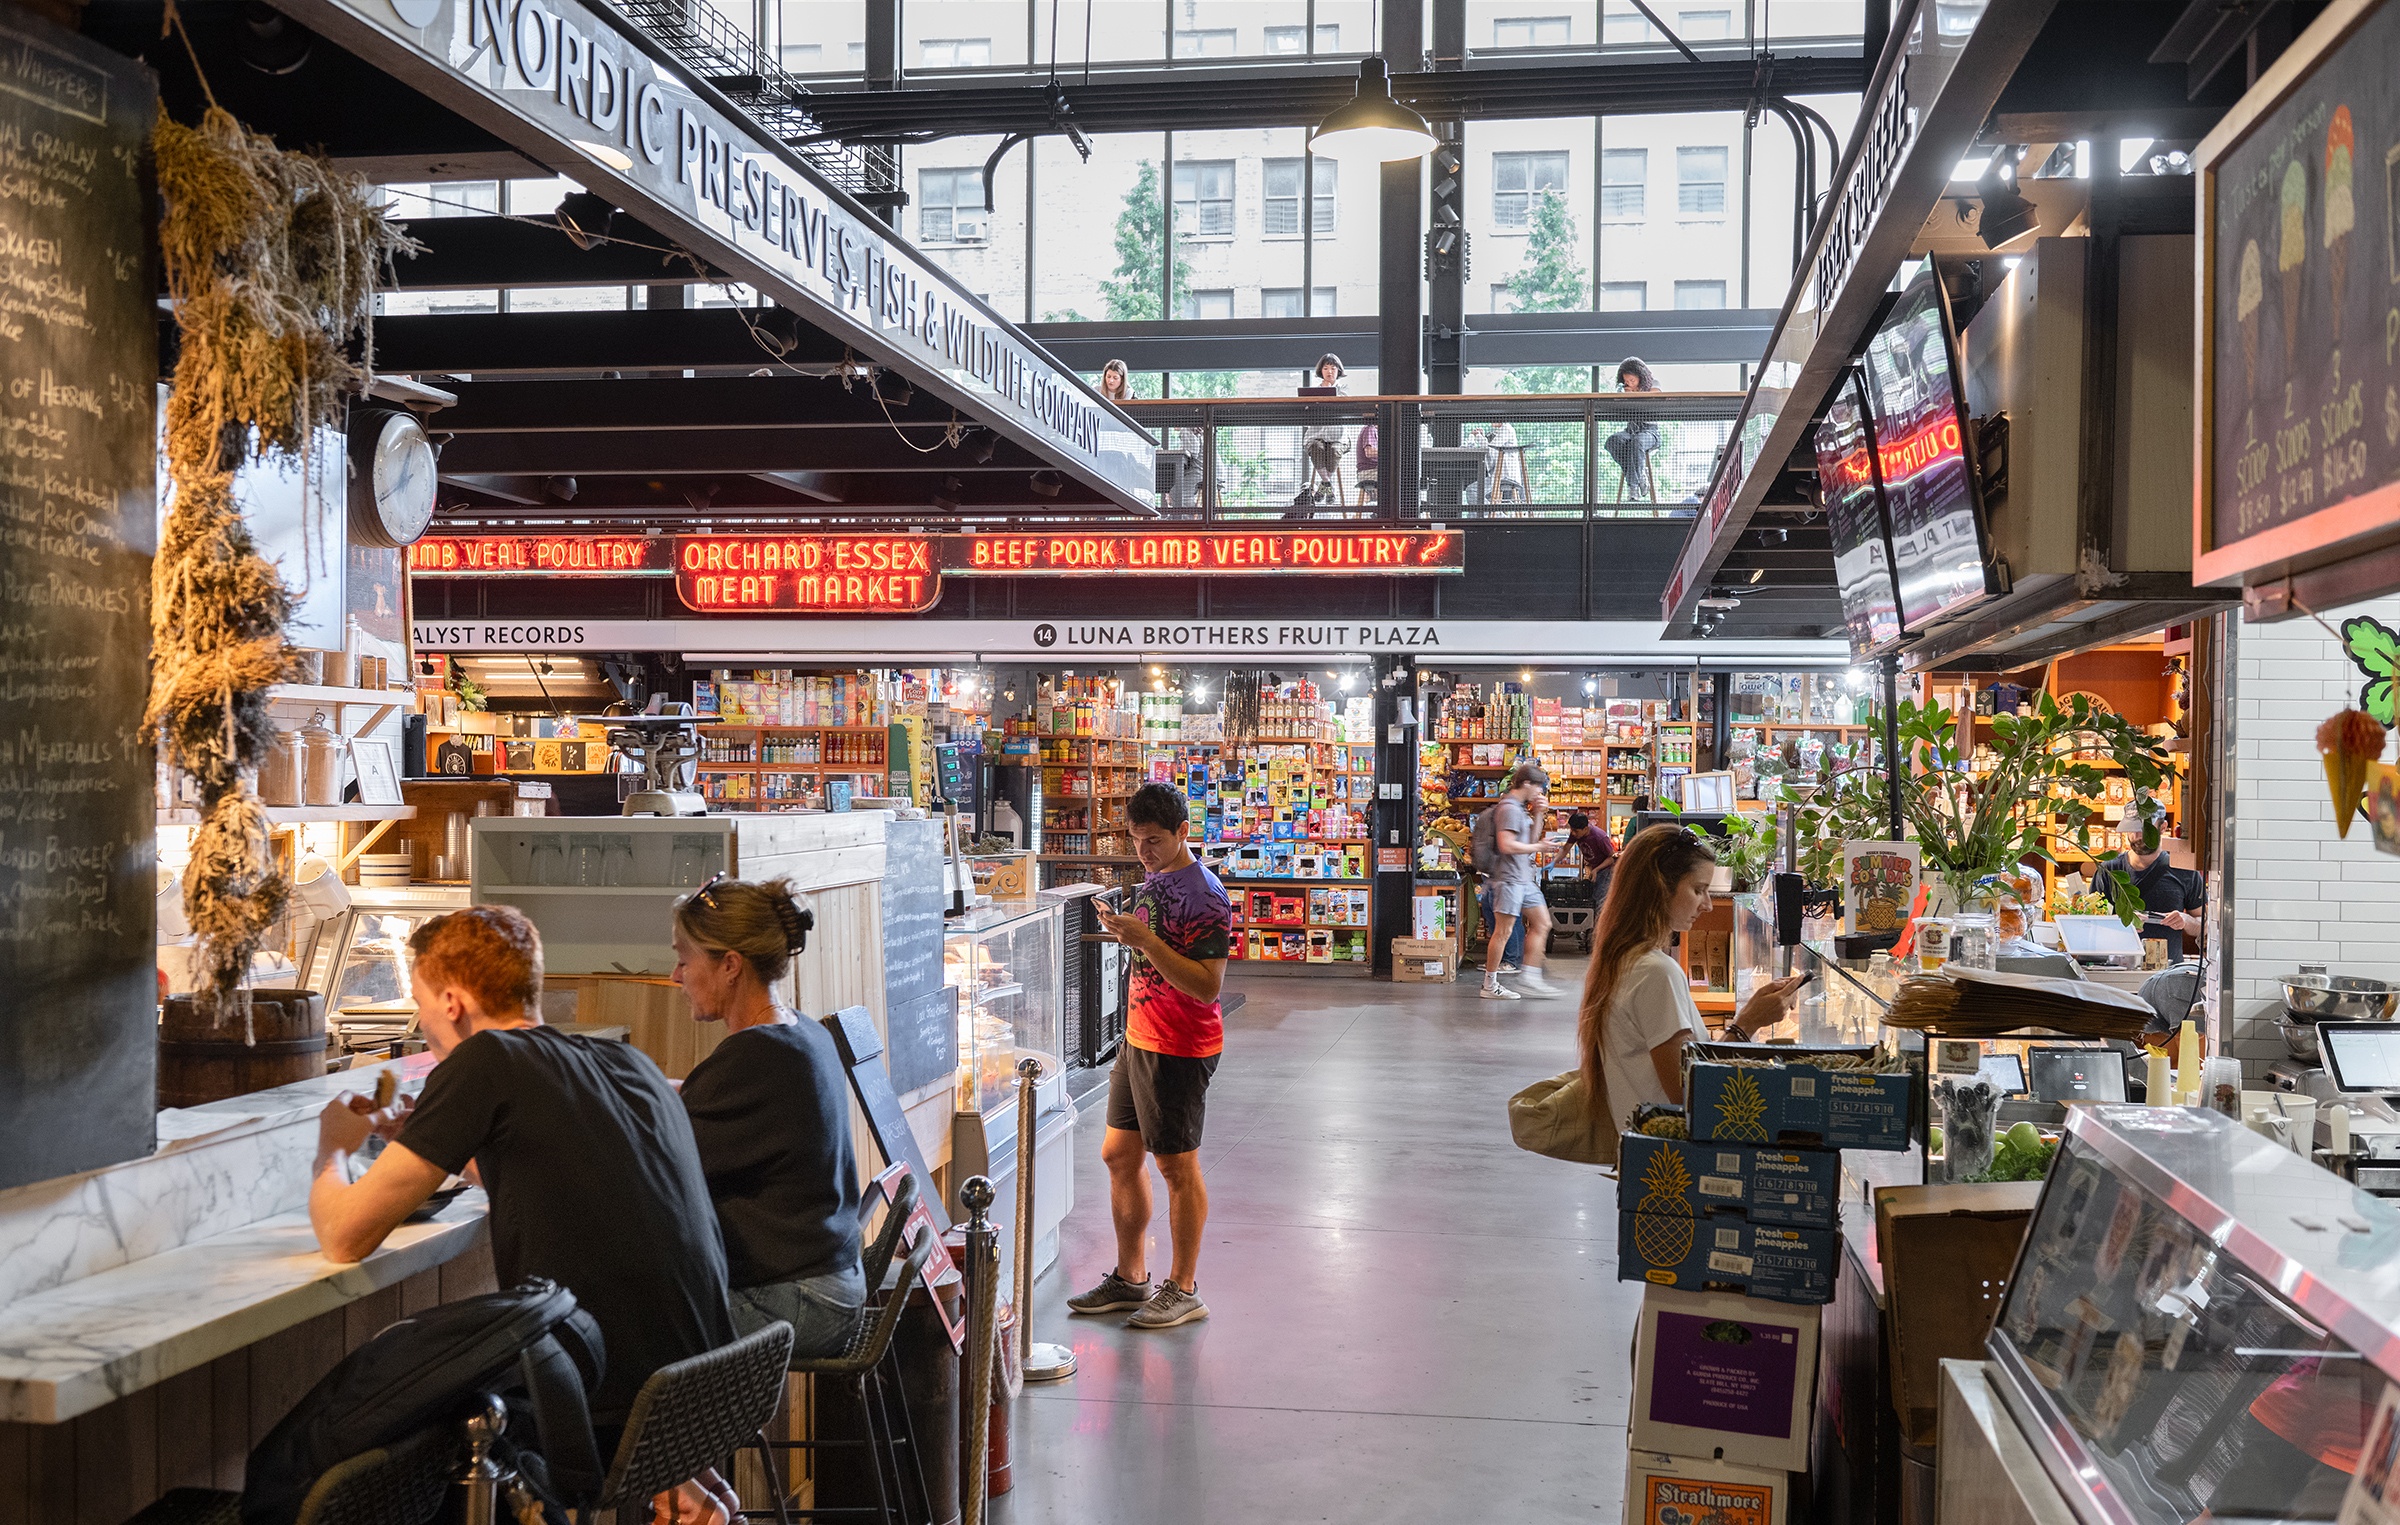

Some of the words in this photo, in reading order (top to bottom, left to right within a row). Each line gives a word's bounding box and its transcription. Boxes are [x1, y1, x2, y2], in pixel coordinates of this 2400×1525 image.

[471, 0, 664, 165] NORDIC
[679, 107, 858, 311] PRESERVES,
[866, 247, 919, 337] FISH
[924, 290, 940, 350] &
[943, 302, 1028, 410] WILDLIFE
[1031, 370, 1101, 457] COMPANY
[463, 544, 525, 567] VEAL
[536, 543, 642, 567] POULTRY
[684, 542, 821, 570] ORCHARD
[837, 542, 929, 570] ESSEX
[975, 539, 1038, 565] BEEF
[1050, 539, 1116, 565] PORK
[1128, 539, 1201, 565] LAMB
[1214, 538, 1282, 564] VEAL
[1293, 537, 1409, 564] POULTRY
[696, 576, 776, 603] MEAT
[797, 576, 922, 604] MARKET
[483, 626, 585, 645] RECORDS
[1067, 627, 1127, 645] LUNA
[1143, 626, 1269, 646] BROTHERS
[1279, 627, 1349, 645] FRUIT
[1359, 627, 1440, 646] PLAZA
[1852, 855, 1912, 872] SUMMER
[1851, 868, 1913, 887] COLADAS
[1831, 1074, 1859, 1084] fresh
[1830, 1084, 1886, 1096] pineapples
[1756, 1151, 1784, 1161] fresh
[1755, 1162, 1810, 1174] pineapples
[1755, 1227, 1782, 1239] fresh
[1754, 1238, 1809, 1250] pineapples
[1712, 1373, 1737, 1382] PRODUCE
[1726, 1368, 1748, 1376] PACKED
[1702, 1400, 1728, 1408] PRODUCE
[1656, 1483, 1761, 1510] Strathmore
